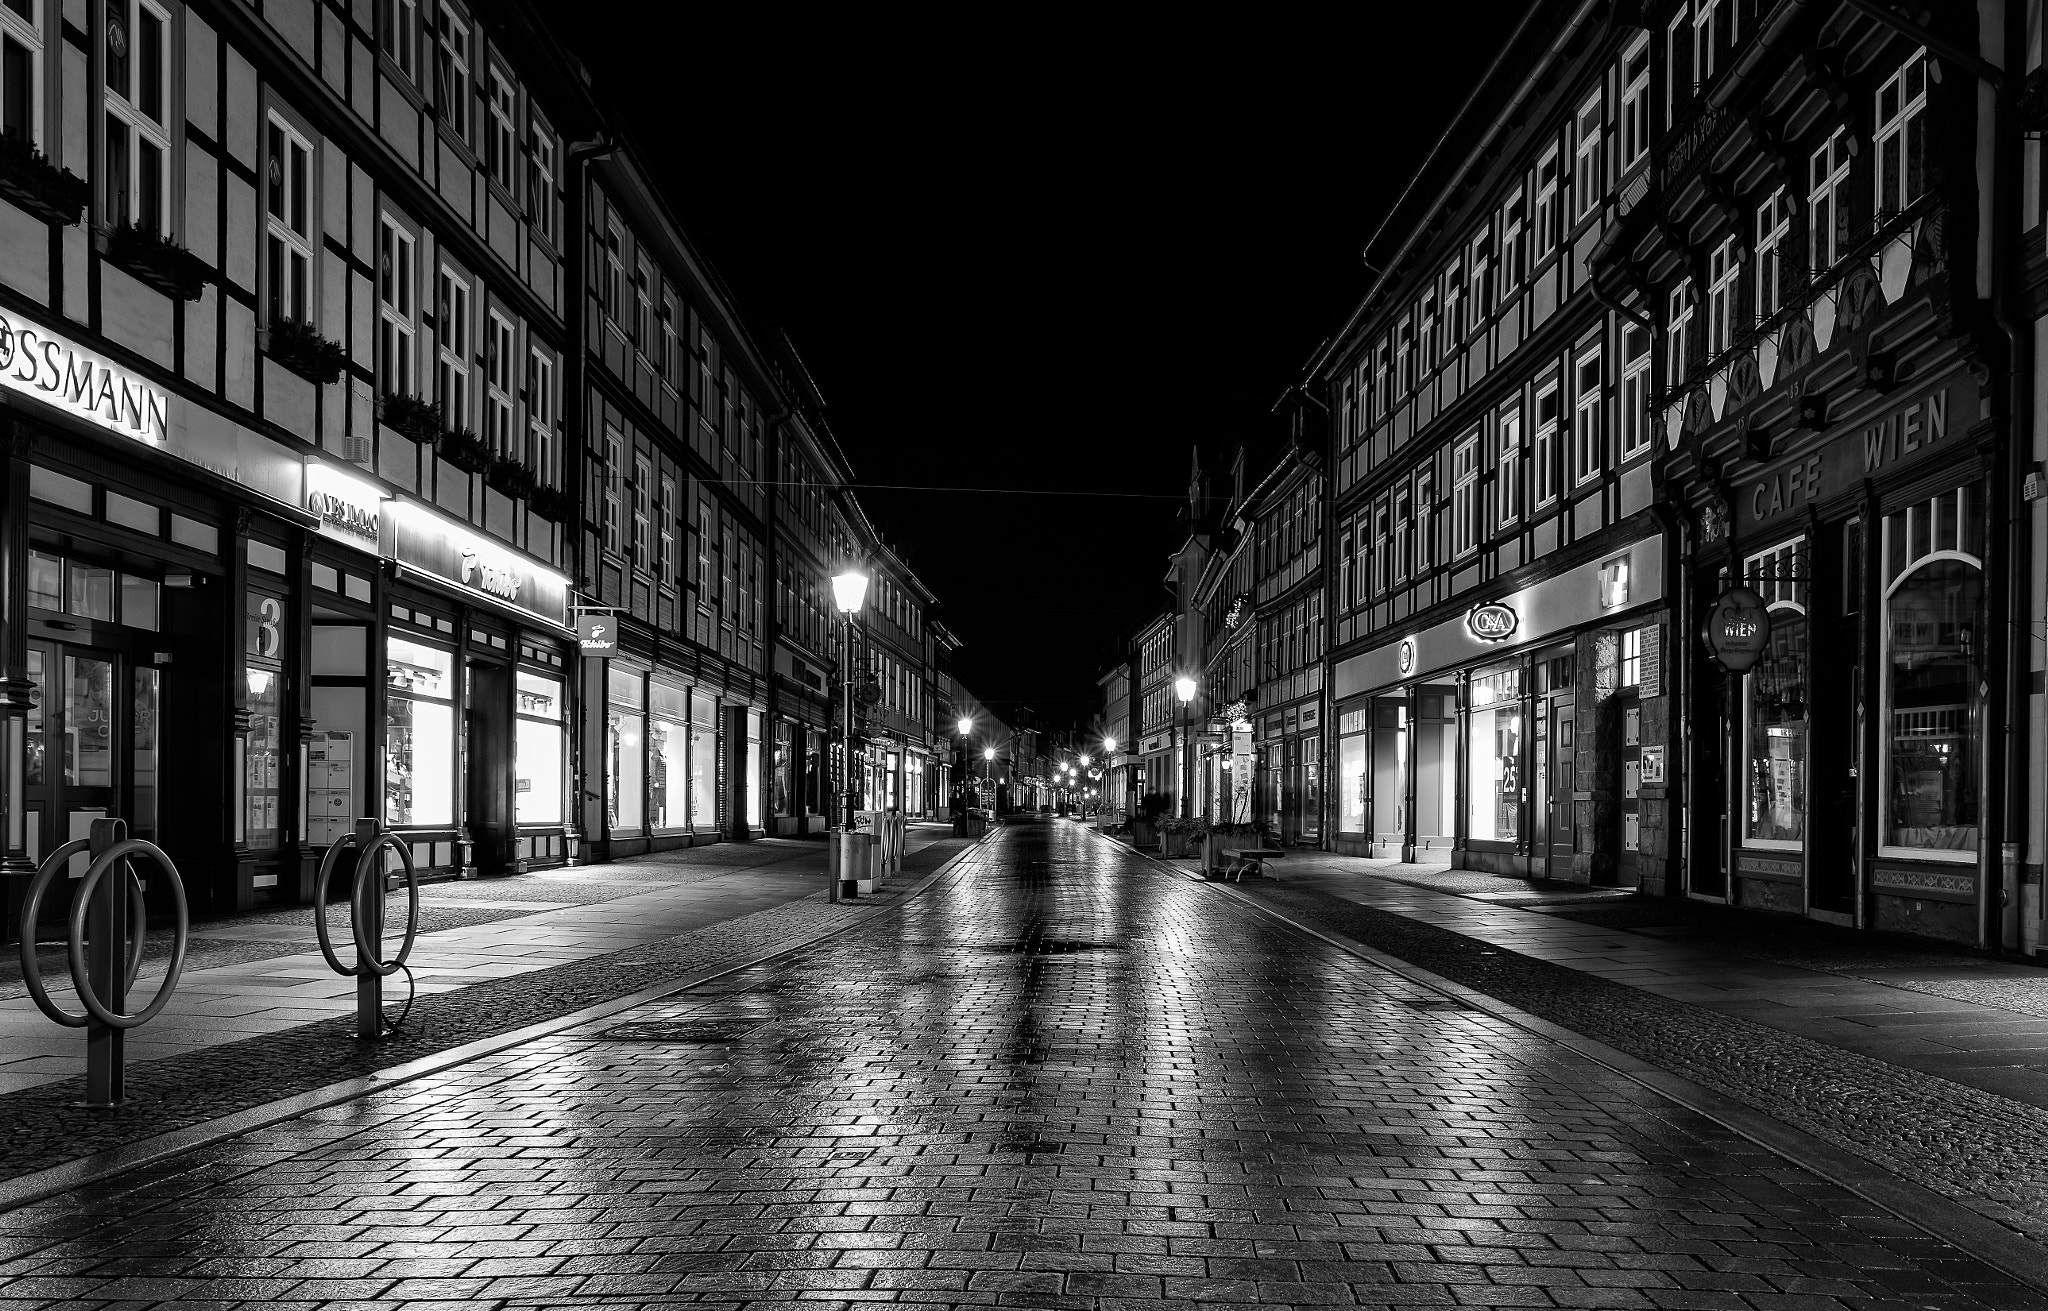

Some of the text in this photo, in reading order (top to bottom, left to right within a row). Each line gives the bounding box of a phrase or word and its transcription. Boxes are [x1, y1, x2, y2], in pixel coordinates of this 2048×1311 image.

[1752, 388, 1950, 521] CAFE WIEN
[1476, 612, 1511, 632] C&A
[1724, 623, 1757, 637] WIEN
[580, 639, 615, 649] Tchibo
